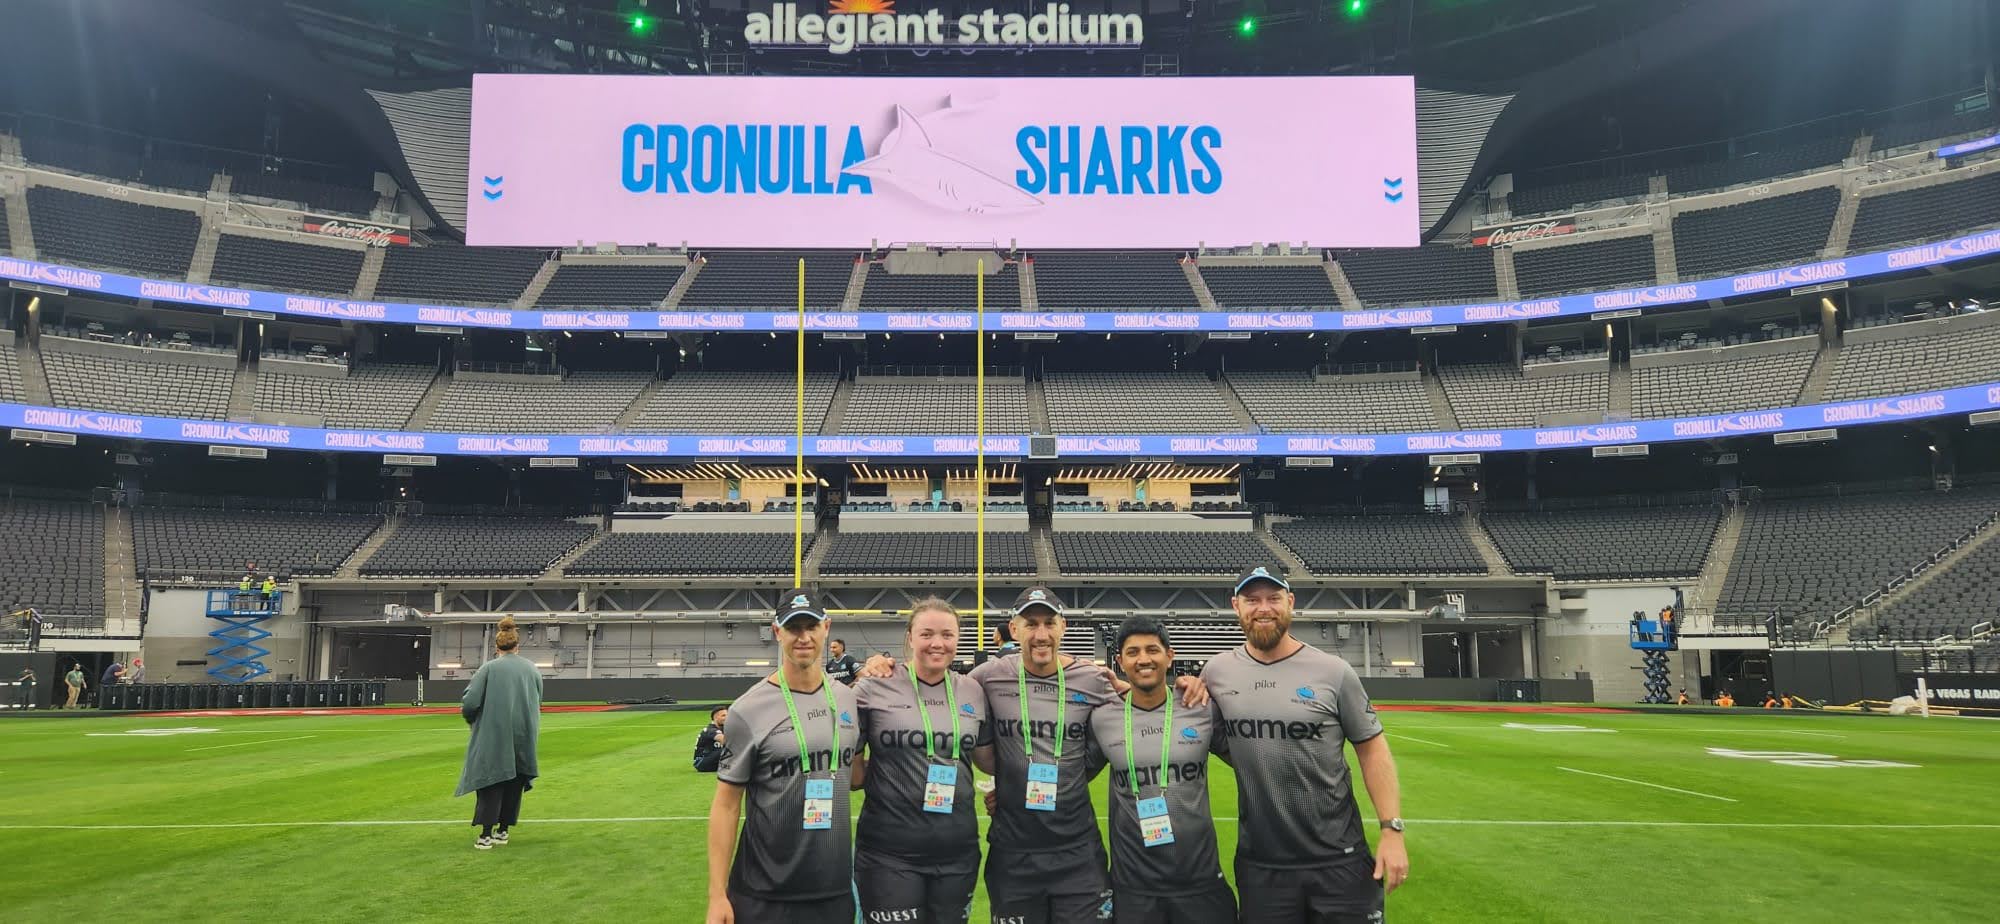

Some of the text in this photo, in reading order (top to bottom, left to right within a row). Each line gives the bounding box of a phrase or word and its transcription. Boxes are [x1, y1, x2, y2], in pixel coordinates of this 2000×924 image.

[744, 3, 1143, 53] allegiant stadium
[622, 123, 1223, 195] CRONULLA SHARKS
[1888, 247, 1945, 268] CRONULLA
[57, 268, 101, 289] SHARKS
[1734, 262, 1847, 291] CRONULLA SHARKS
[140, 281, 250, 306] CRONULLA SHARKS
[1594, 285, 1697, 308] CRONULLA SHARKS
[286, 297, 385, 319] CRONULLA SHARKS
[1464, 301, 1560, 320] CRONULLA SHARKS
[418, 308, 512, 325] CRONULLA SHARKS
[542, 313, 629, 327] CRONULLA SHARKS
[658, 314, 744, 327] CRONULLA SHARKS
[773, 315, 859, 328] CRONULA SHARKS
[888, 315, 972, 328] CRONULLA SHARKS
[1001, 315, 1085, 328] CRONULLA SHARKS
[1114, 315, 1199, 328] CRONULLA SHARKS
[1228, 314, 1313, 327] CRONULLA SHARKS
[1343, 311, 1432, 326] CRONULLA SHARKS
[1824, 395, 1945, 423] CRONULLA SHARKS
[24, 409, 142, 433] CRONULLA SHARKS
[1673, 413, 1783, 436] CRONULLA SHARKS
[182, 422, 290, 444] CRONULLA SHARKS
[325, 432, 425, 449] CRONULLA SHARKS
[1535, 425, 1637, 446] CRONULLA SHARKS
[458, 437, 549, 452] CRONULLA SHARKS
[581, 438, 669, 452] CRONULLA SHARKS
[699, 438, 787, 452] CRONULLA SHARKS
[817, 439, 905, 452] CRONULLA SHARKS
[934, 439, 1020, 452] CRONULLA SHARKS
[1058, 438, 1140, 452] RONULLA SHARKS
[1170, 438, 1258, 451] CRONULLA SHARKS
[1288, 438, 1375, 451] CRONULLA SHARKS
[1407, 433, 1502, 450] CRONULLA SHARKS
[1034, 685, 1056, 694] pilot
[1254, 679, 1276, 690] pilot
[1936, 688, 1970, 699] VEGAS
[924, 698, 945, 707] pilot
[807, 709, 828, 721] pilot
[1141, 726, 1164, 738] pilot
[880, 729, 978, 752] arame
[870, 908, 918, 924] QUEST
